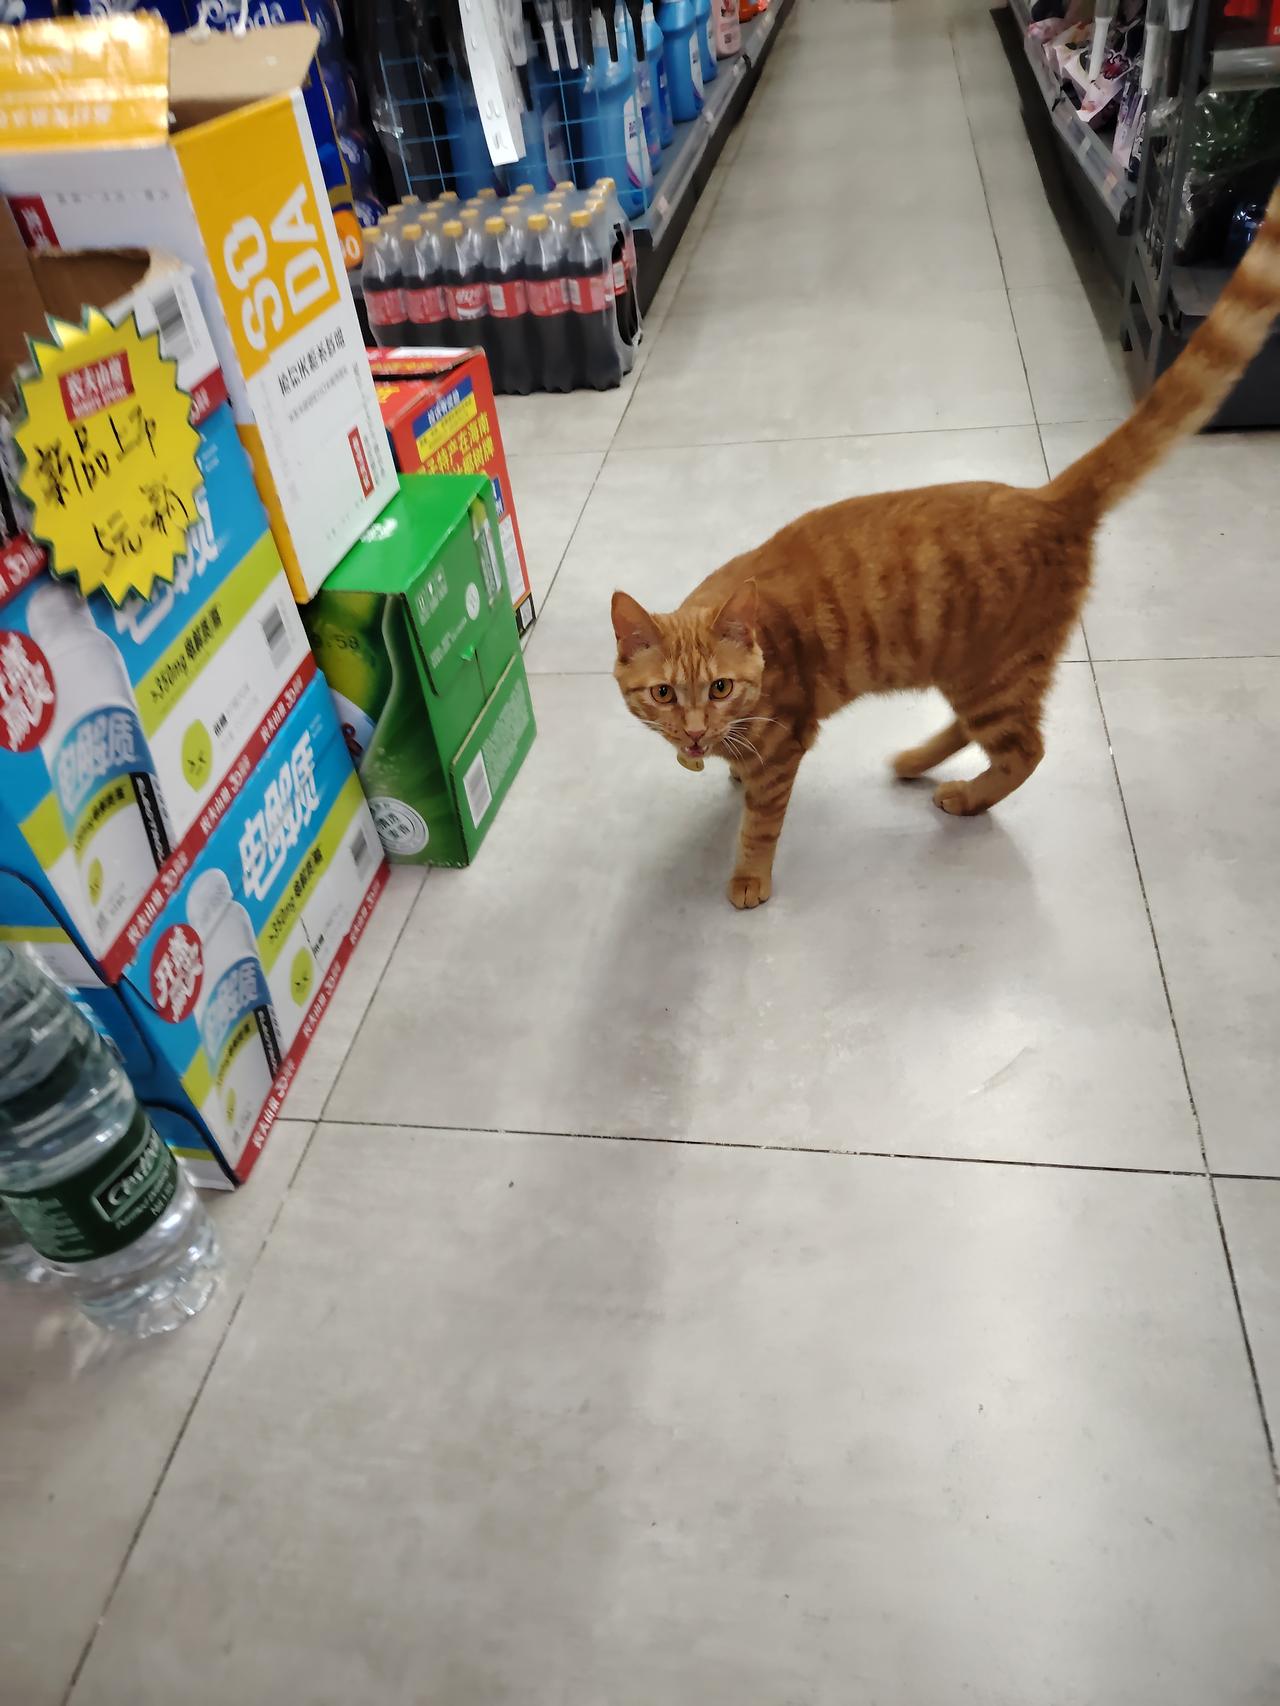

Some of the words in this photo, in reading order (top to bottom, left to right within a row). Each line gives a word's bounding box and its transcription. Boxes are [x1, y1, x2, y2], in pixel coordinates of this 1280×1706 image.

[223, 215, 286, 352] SO
[270, 181, 333, 317] DA
[238, 729, 322, 903] 电解质
